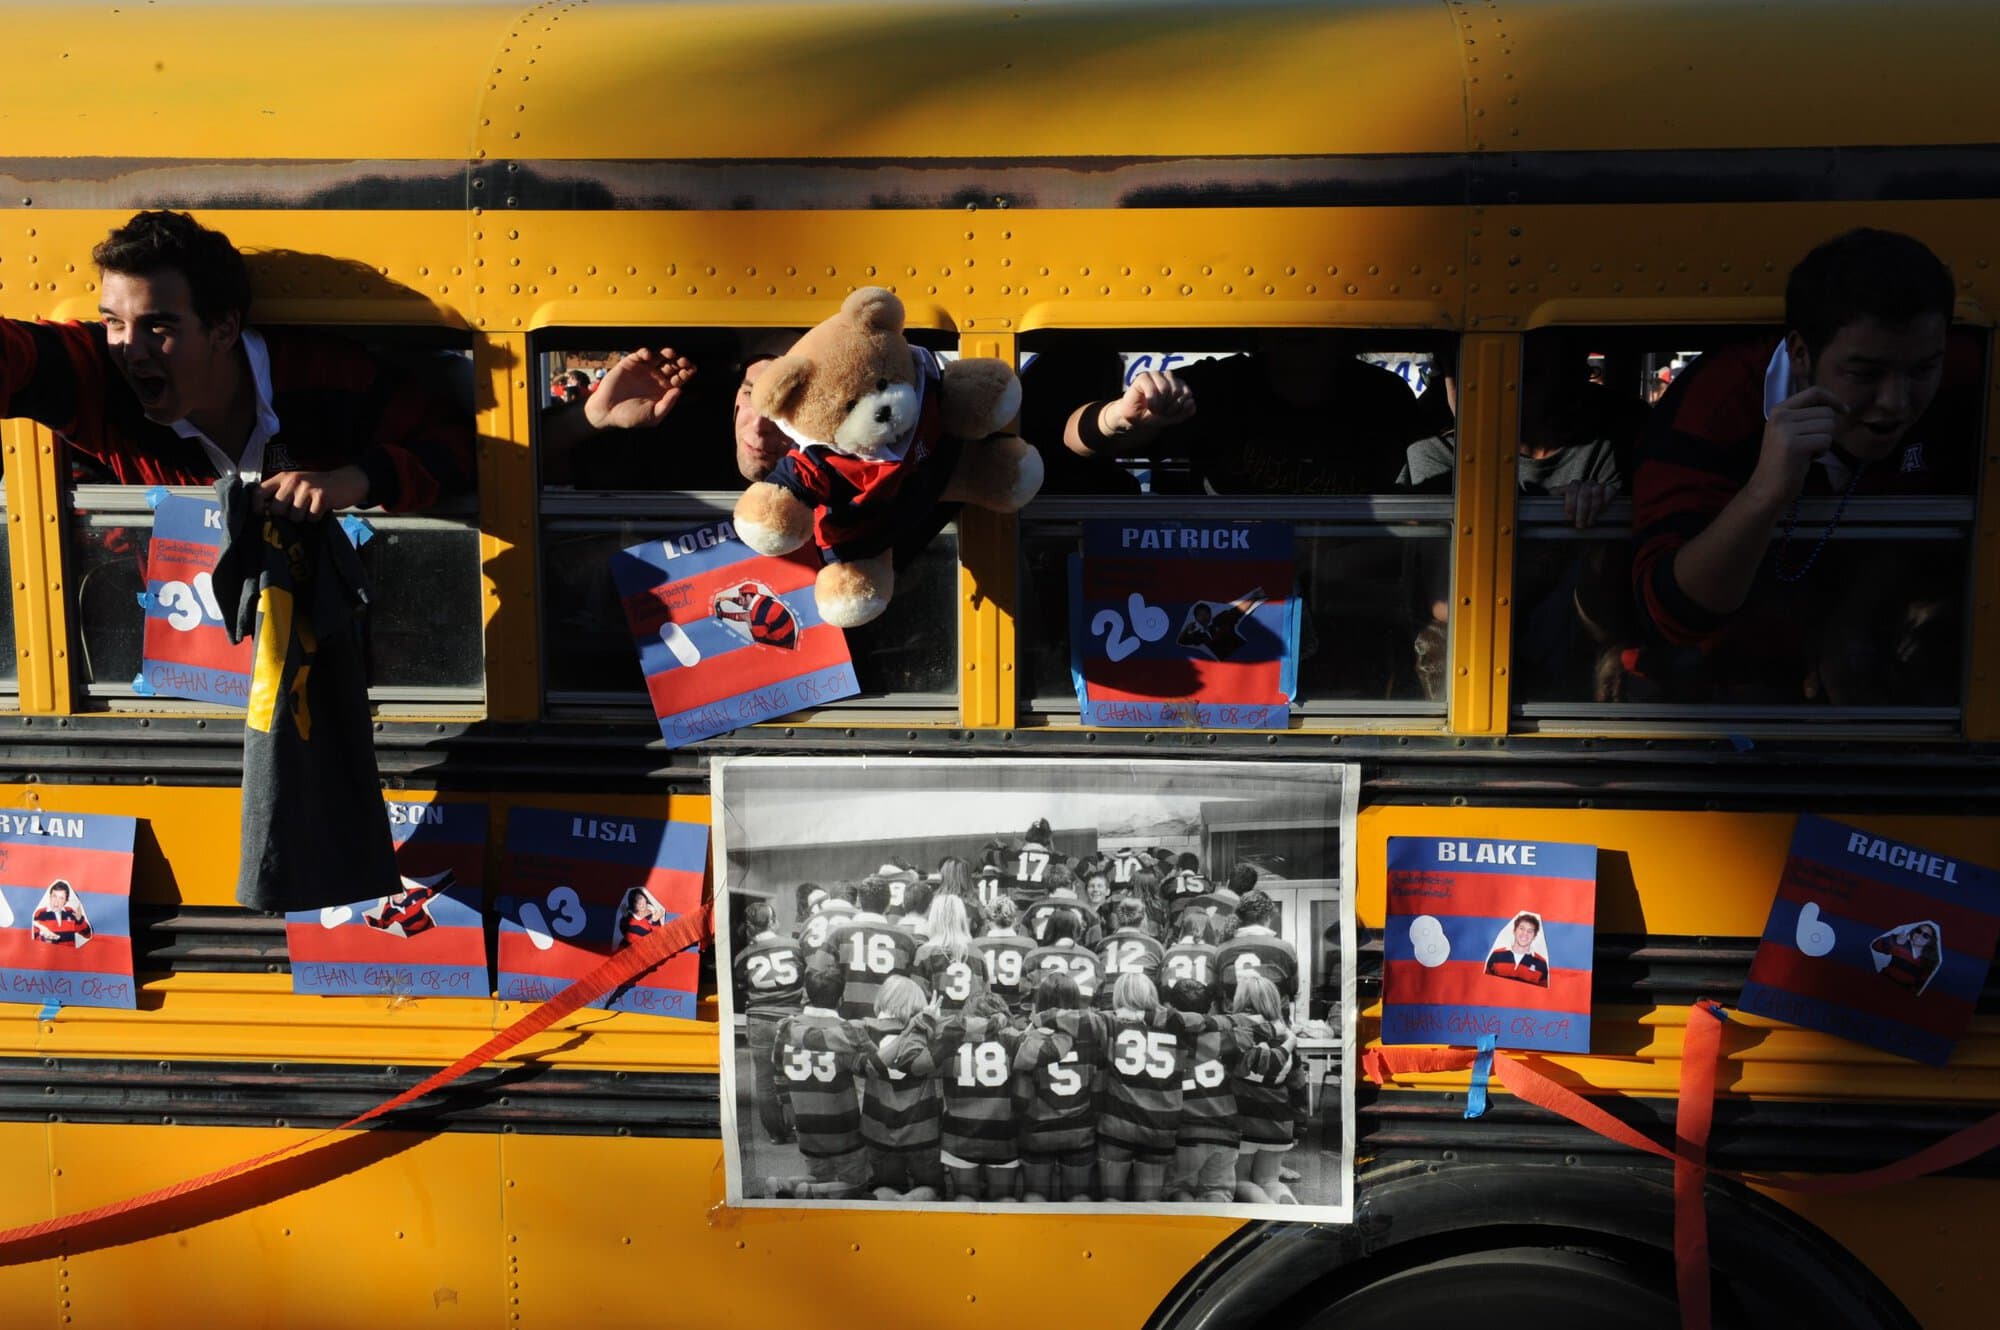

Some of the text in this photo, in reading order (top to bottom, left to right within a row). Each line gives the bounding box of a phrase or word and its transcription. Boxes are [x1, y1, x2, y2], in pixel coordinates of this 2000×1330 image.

[662, 520, 737, 560] LOGA
[1122, 528, 1250, 549] PATRICK
[660, 622, 700, 667] 1
[1091, 592, 1170, 663] 26
[151, 664, 250, 697] CHAIN GAN
[672, 671, 849, 740] CHAIN GANG 08-09
[1097, 704, 1269, 727] CHAIN GANG 08-09
[572, 818, 637, 843] LISA
[1017, 852, 1050, 882] 17
[1438, 842, 1537, 865] BLAKE
[1847, 832, 1958, 884] RACHEL
[1176, 873, 1204, 894] 15
[519, 886, 587, 950] 13
[1796, 901, 1836, 957] 6
[850, 931, 895, 974] 16
[1105, 940, 1145, 973] 12
[1409, 915, 1450, 967] 8
[302, 966, 470, 990] CHAIN GANG 08-09
[747, 951, 798, 988] 25
[945, 962, 971, 1000] 3
[984, 950, 1022, 985] 19
[14, 975, 72, 996] GANG
[81, 978, 129, 1003] 08-09
[634, 991, 683, 1011] 08-09
[1448, 1012, 1500, 1035] GANG
[1511, 1017, 1570, 1040] 08-09
[957, 1041, 1008, 1087] 18
[1115, 1029, 1176, 1079] 35
